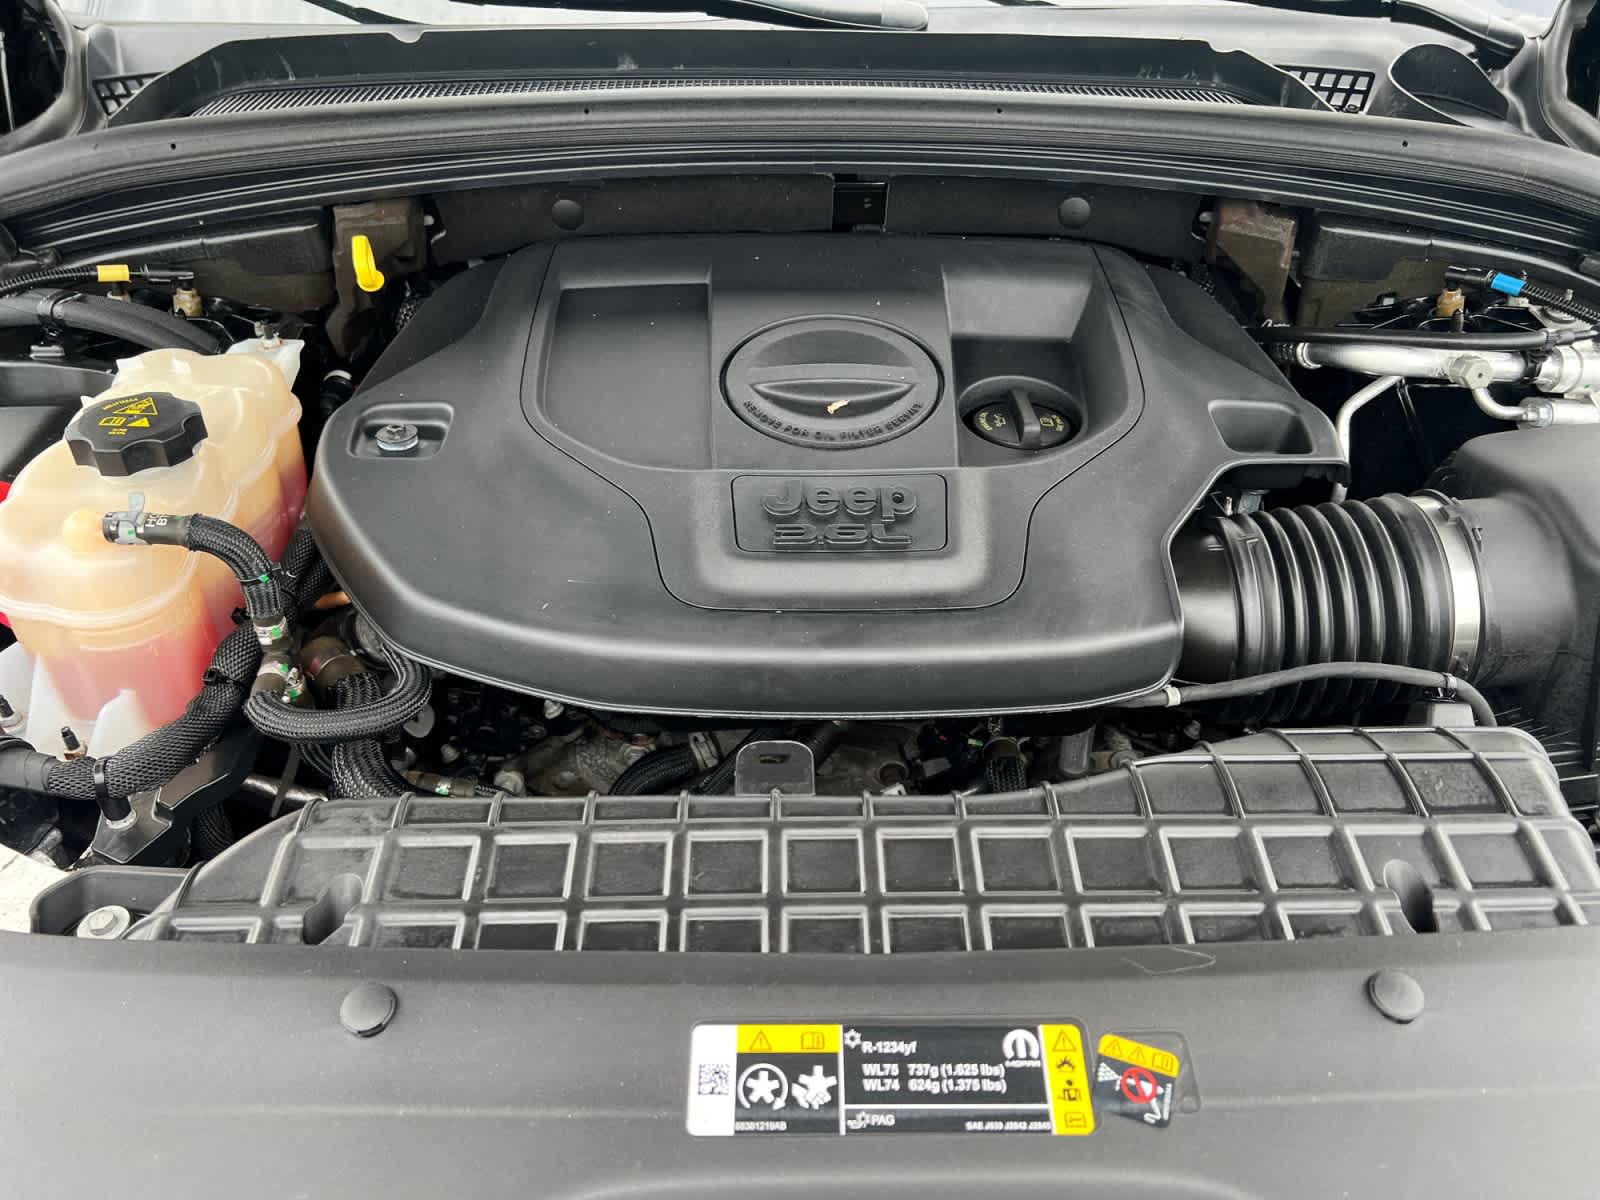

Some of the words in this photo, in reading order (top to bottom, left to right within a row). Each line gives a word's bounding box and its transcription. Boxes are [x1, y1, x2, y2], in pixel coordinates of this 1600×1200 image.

[762, 480, 917, 522] Jeep
[773, 523, 912, 545] 3.6L
[861, 1040, 917, 1056] R-1234yf
[862, 1063, 899, 1076] WL75
[907, 1063, 939, 1078] 737g
[940, 1063, 979, 1078] (1.625
[980, 1063, 1005, 1078] lbs)
[863, 1078, 900, 1091] WL74
[981, 1078, 1007, 1094] lbs)
[871, 1115, 895, 1126] PAG
